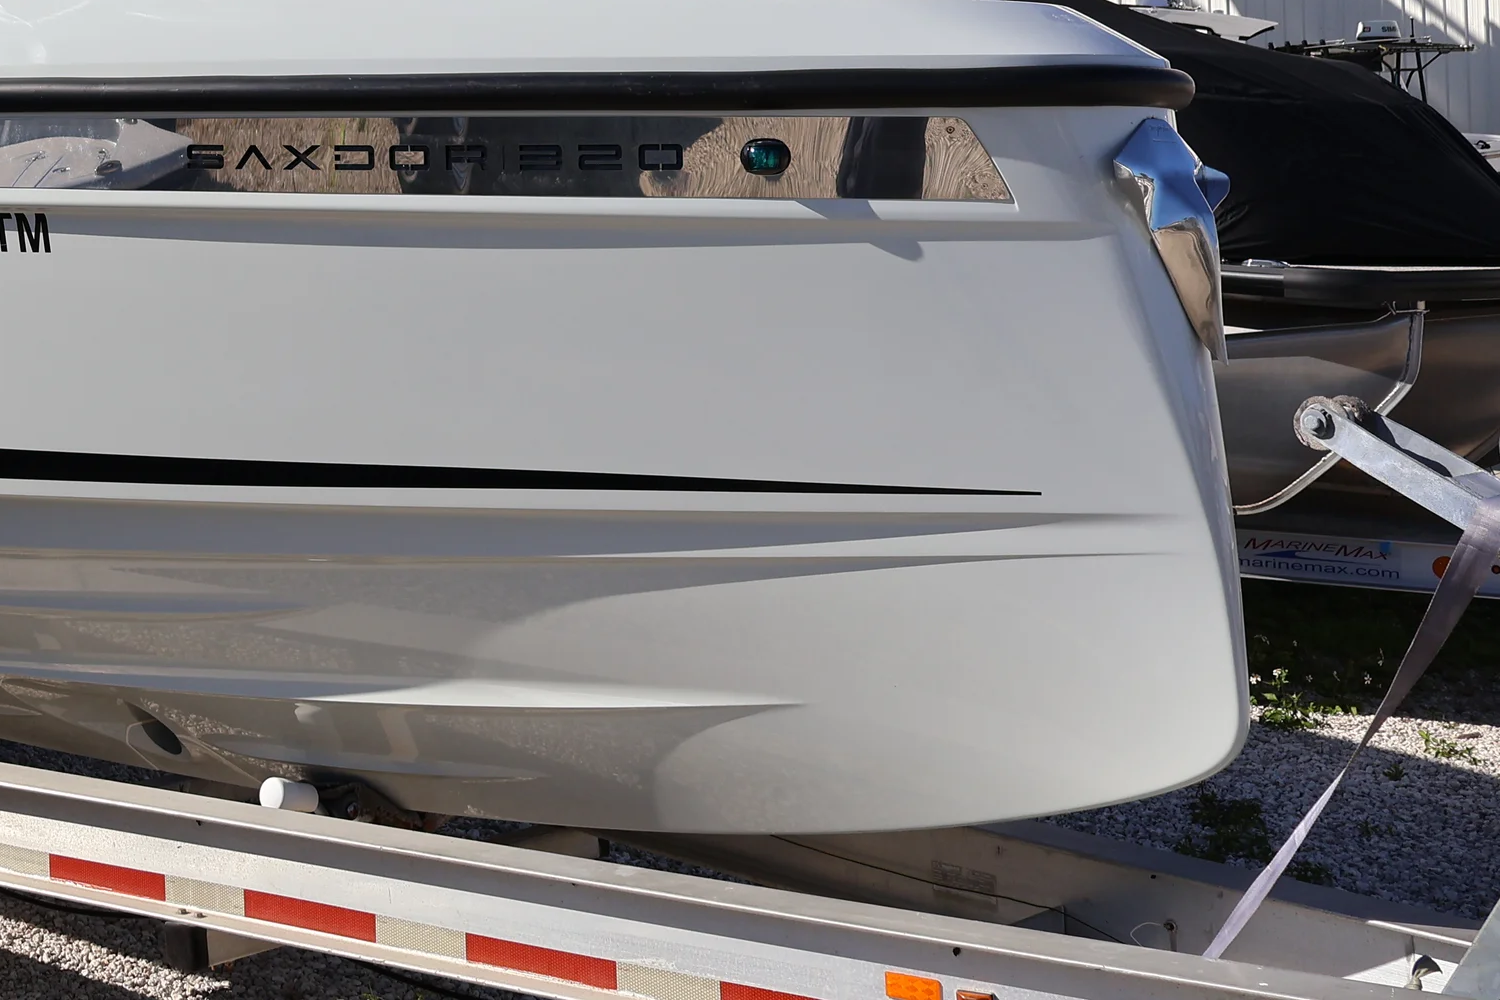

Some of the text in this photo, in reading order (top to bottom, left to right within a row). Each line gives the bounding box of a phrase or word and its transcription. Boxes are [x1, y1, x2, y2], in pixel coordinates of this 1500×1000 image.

[186, 143, 684, 172] SAXDOR 320
[1238, 557, 1400, 580] marinemax.com
